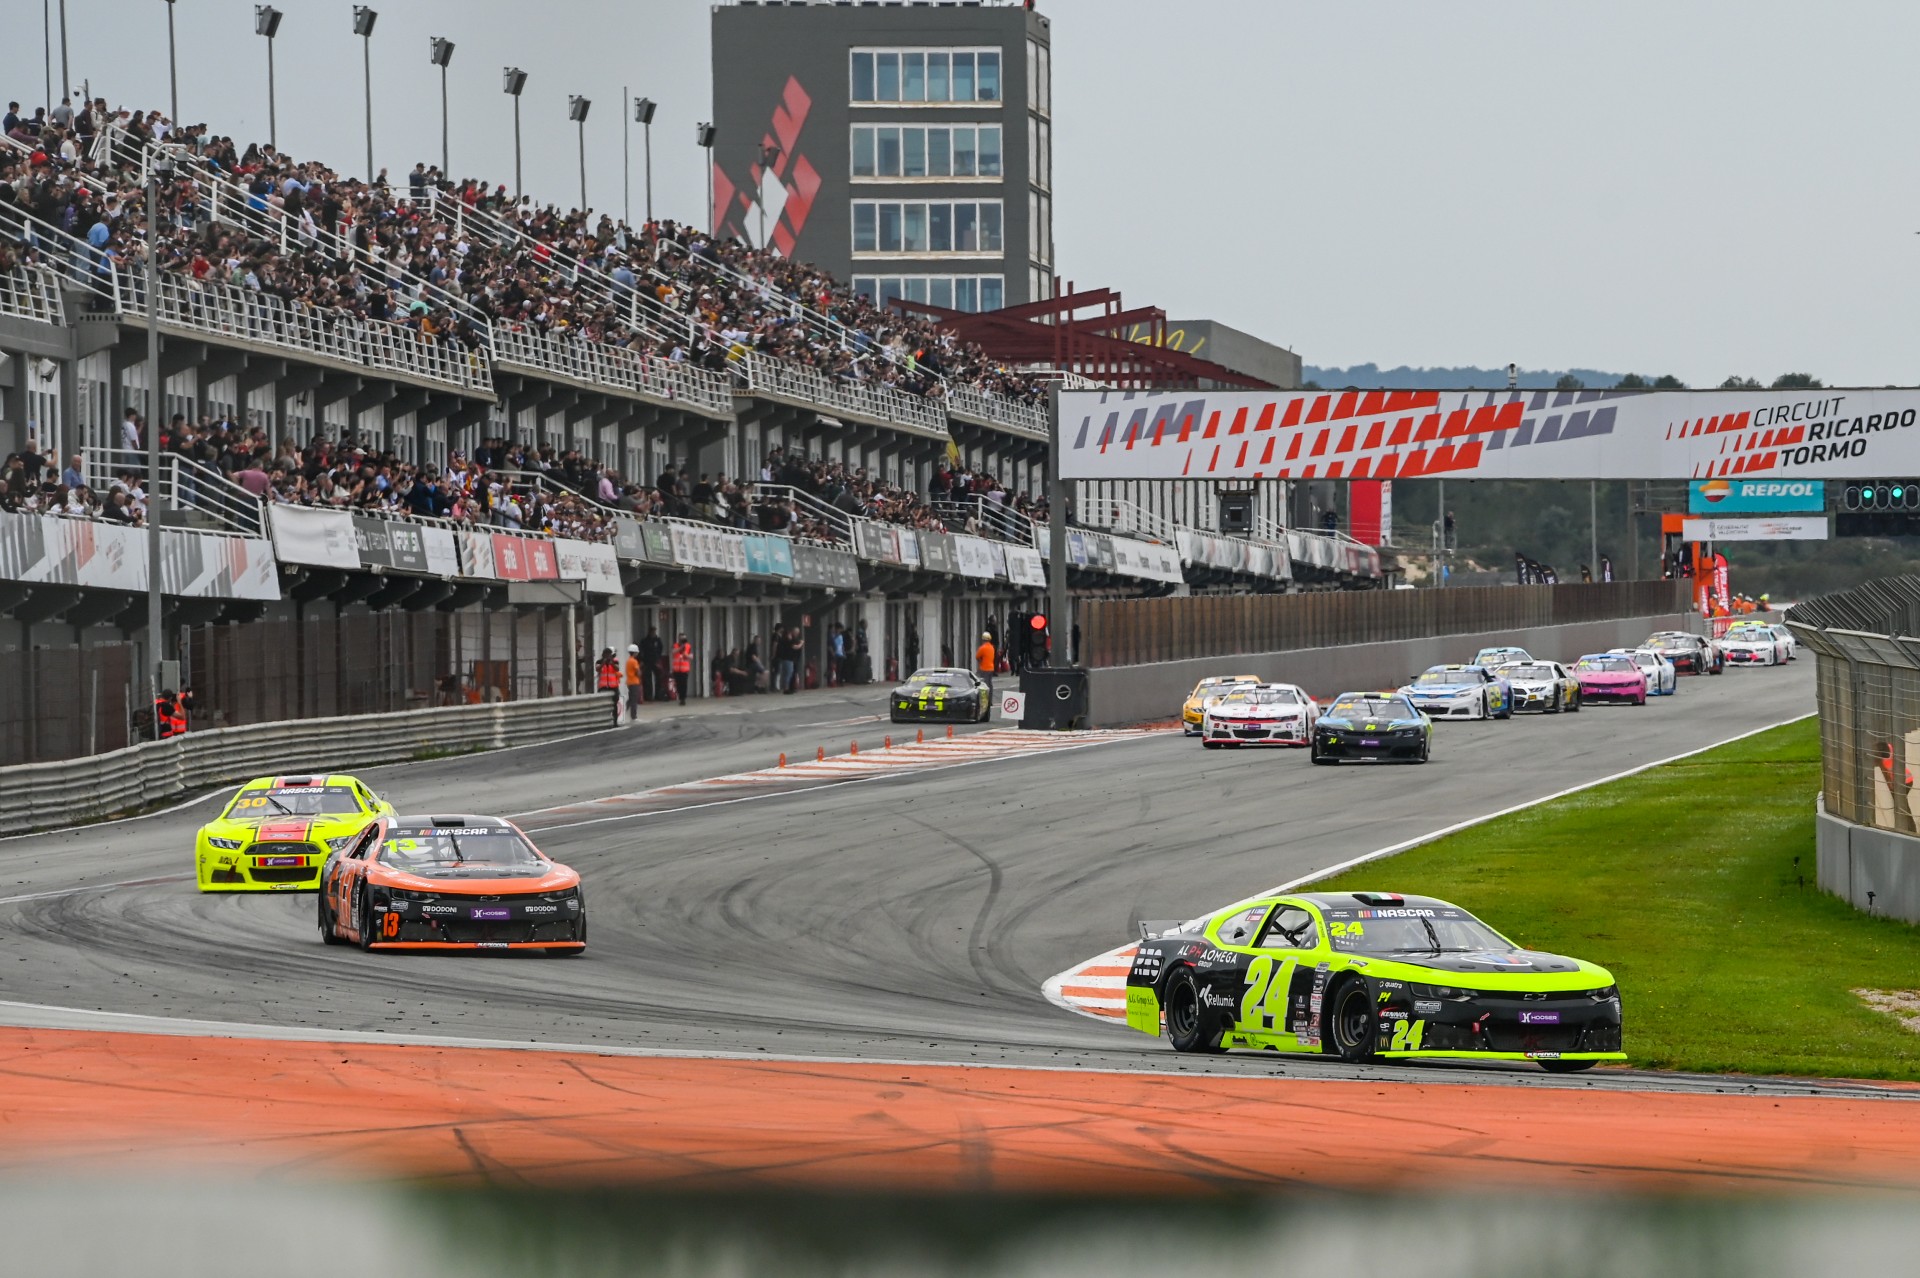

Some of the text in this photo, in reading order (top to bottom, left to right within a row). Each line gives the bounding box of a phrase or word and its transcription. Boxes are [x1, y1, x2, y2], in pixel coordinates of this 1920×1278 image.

[1753, 396, 1846, 427] CIRCUIT
[1807, 408, 1917, 441] RICARDO
[1780, 437, 1868, 467] TORMO
[1741, 482, 1815, 497] REPSOL
[279, 787, 325, 795] NASCAR
[235, 797, 267, 809] 30
[436, 828, 489, 836] NASCAR
[383, 838, 418, 853] 13
[430, 905, 458, 913] DODONI
[1377, 908, 1436, 918] NASCAR
[383, 912, 399, 937] 13
[1329, 921, 1364, 937] 24
[1177, 945, 1238, 965] ALPHAOMEGA
[1197, 960, 1213, 968] GROUP
[1208, 994, 1236, 1008] Rellumix
[1240, 954, 1299, 1034] 24
[1390, 1019, 1426, 1051] 24
